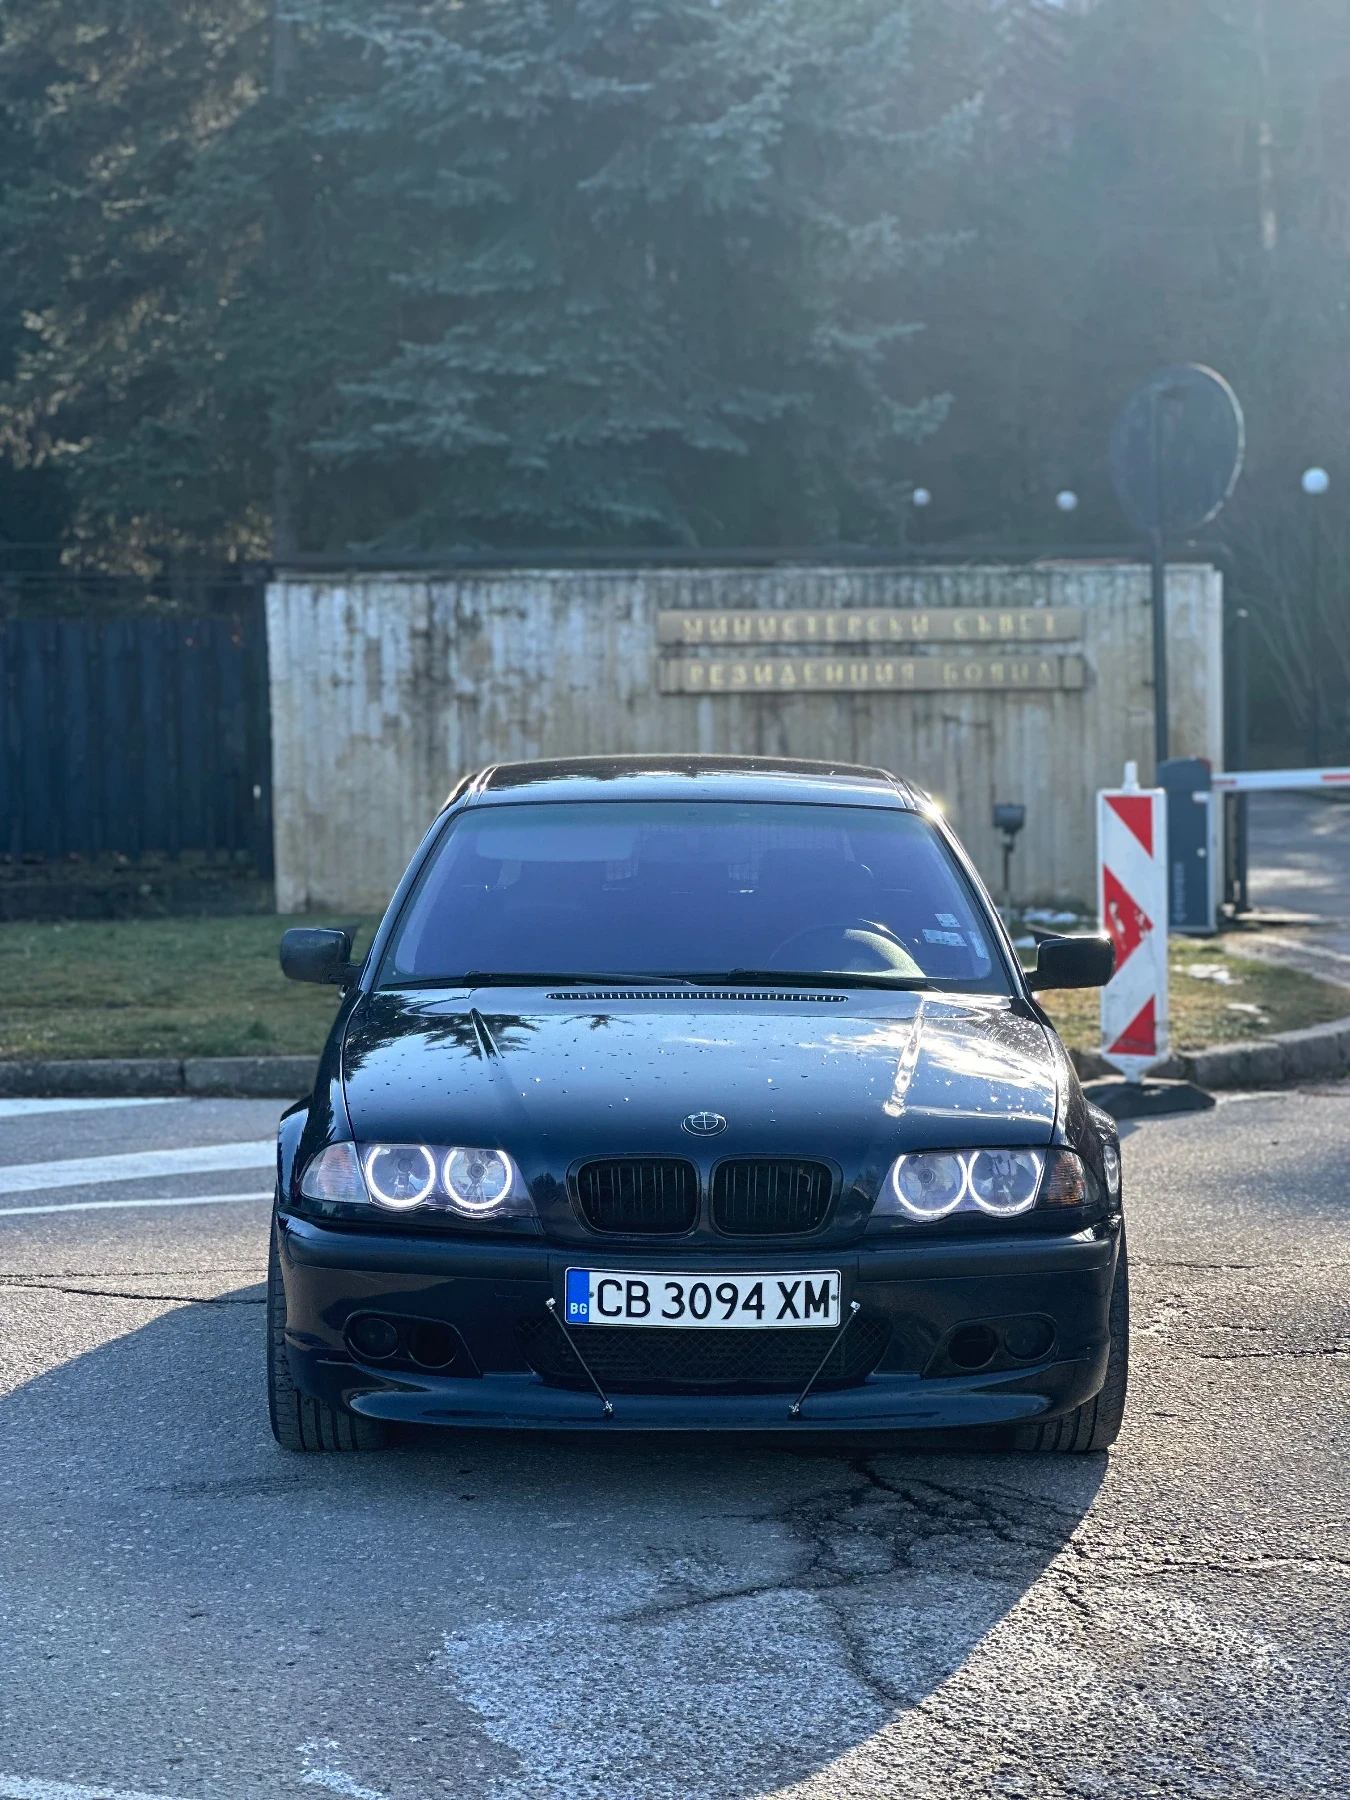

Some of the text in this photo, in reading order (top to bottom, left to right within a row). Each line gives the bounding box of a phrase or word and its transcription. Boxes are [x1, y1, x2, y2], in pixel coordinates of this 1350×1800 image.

[570, 1302, 588, 1315] BG
[597, 1278, 832, 1321] CB 3094 XM
